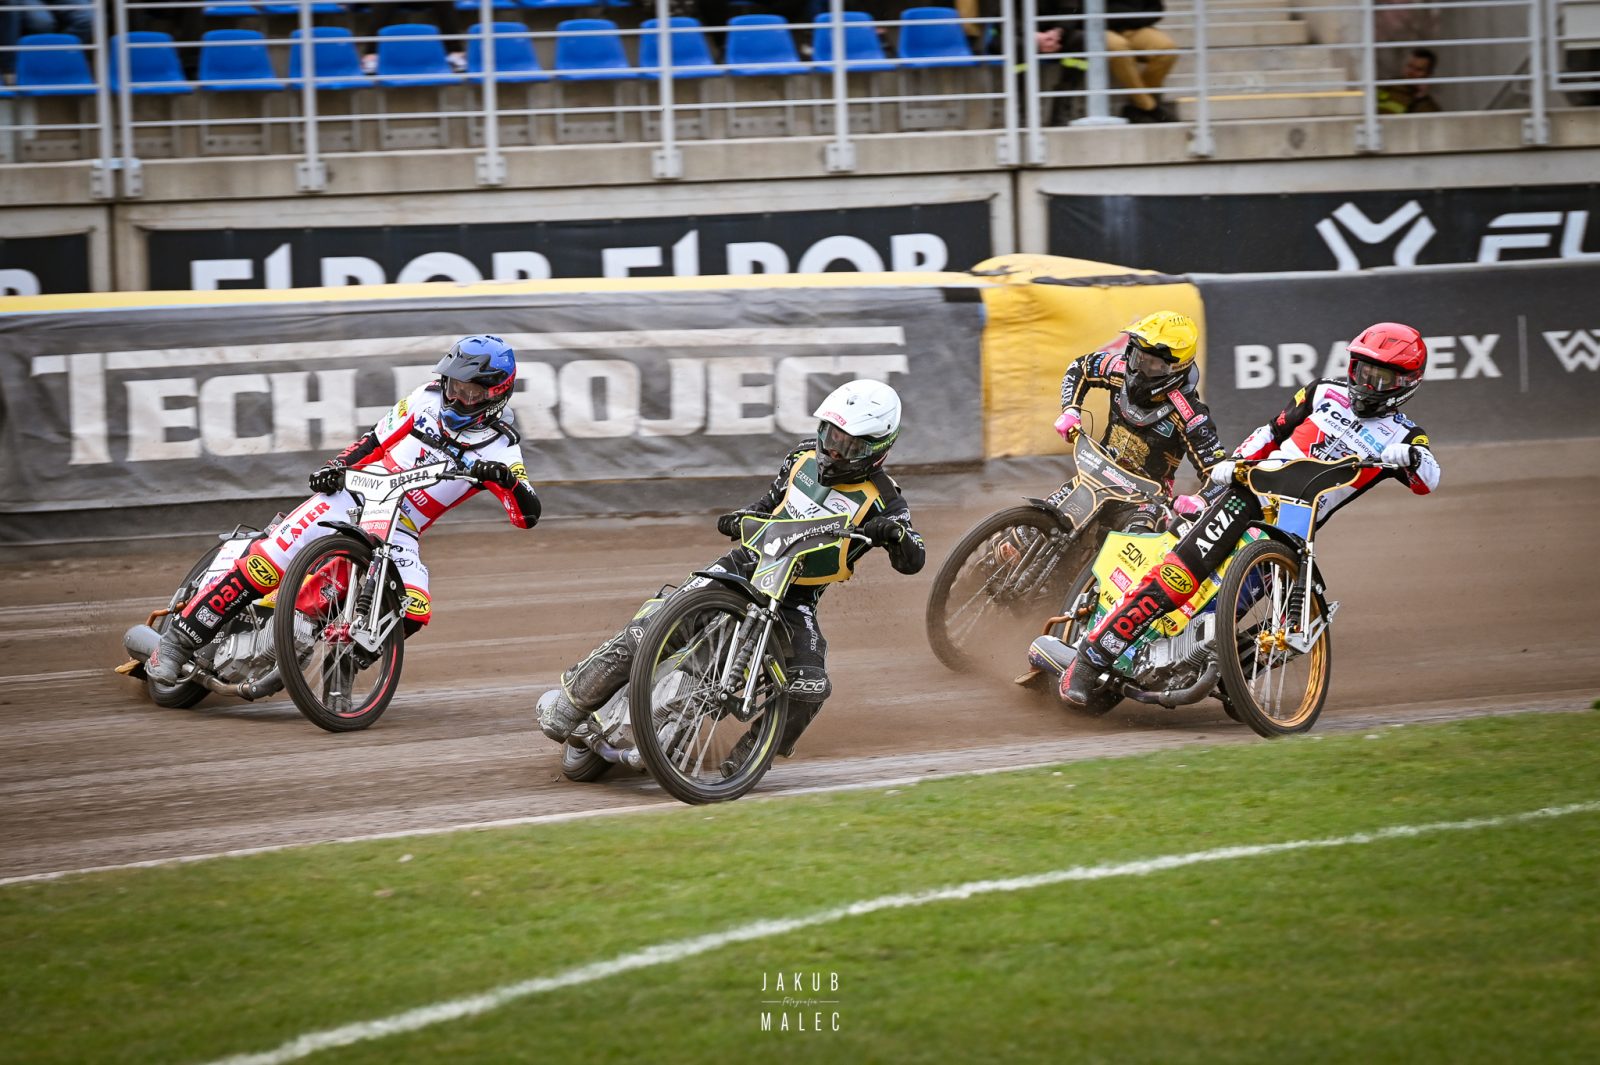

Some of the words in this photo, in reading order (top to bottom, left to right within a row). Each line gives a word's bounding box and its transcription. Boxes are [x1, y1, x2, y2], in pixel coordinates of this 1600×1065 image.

[1234, 334, 1501, 389] BRAEX
[351, 475, 384, 490] RYNNY
[389, 470, 430, 489] BRYZA
[832, 502, 847, 513] PGE
[276, 502, 331, 552] LATER
[1195, 509, 1235, 559] AGZ
[1121, 541, 1146, 568] SON
[1113, 595, 1159, 639] pan
[178, 620, 203, 644] WALBUD
[788, 678, 827, 693] pod
